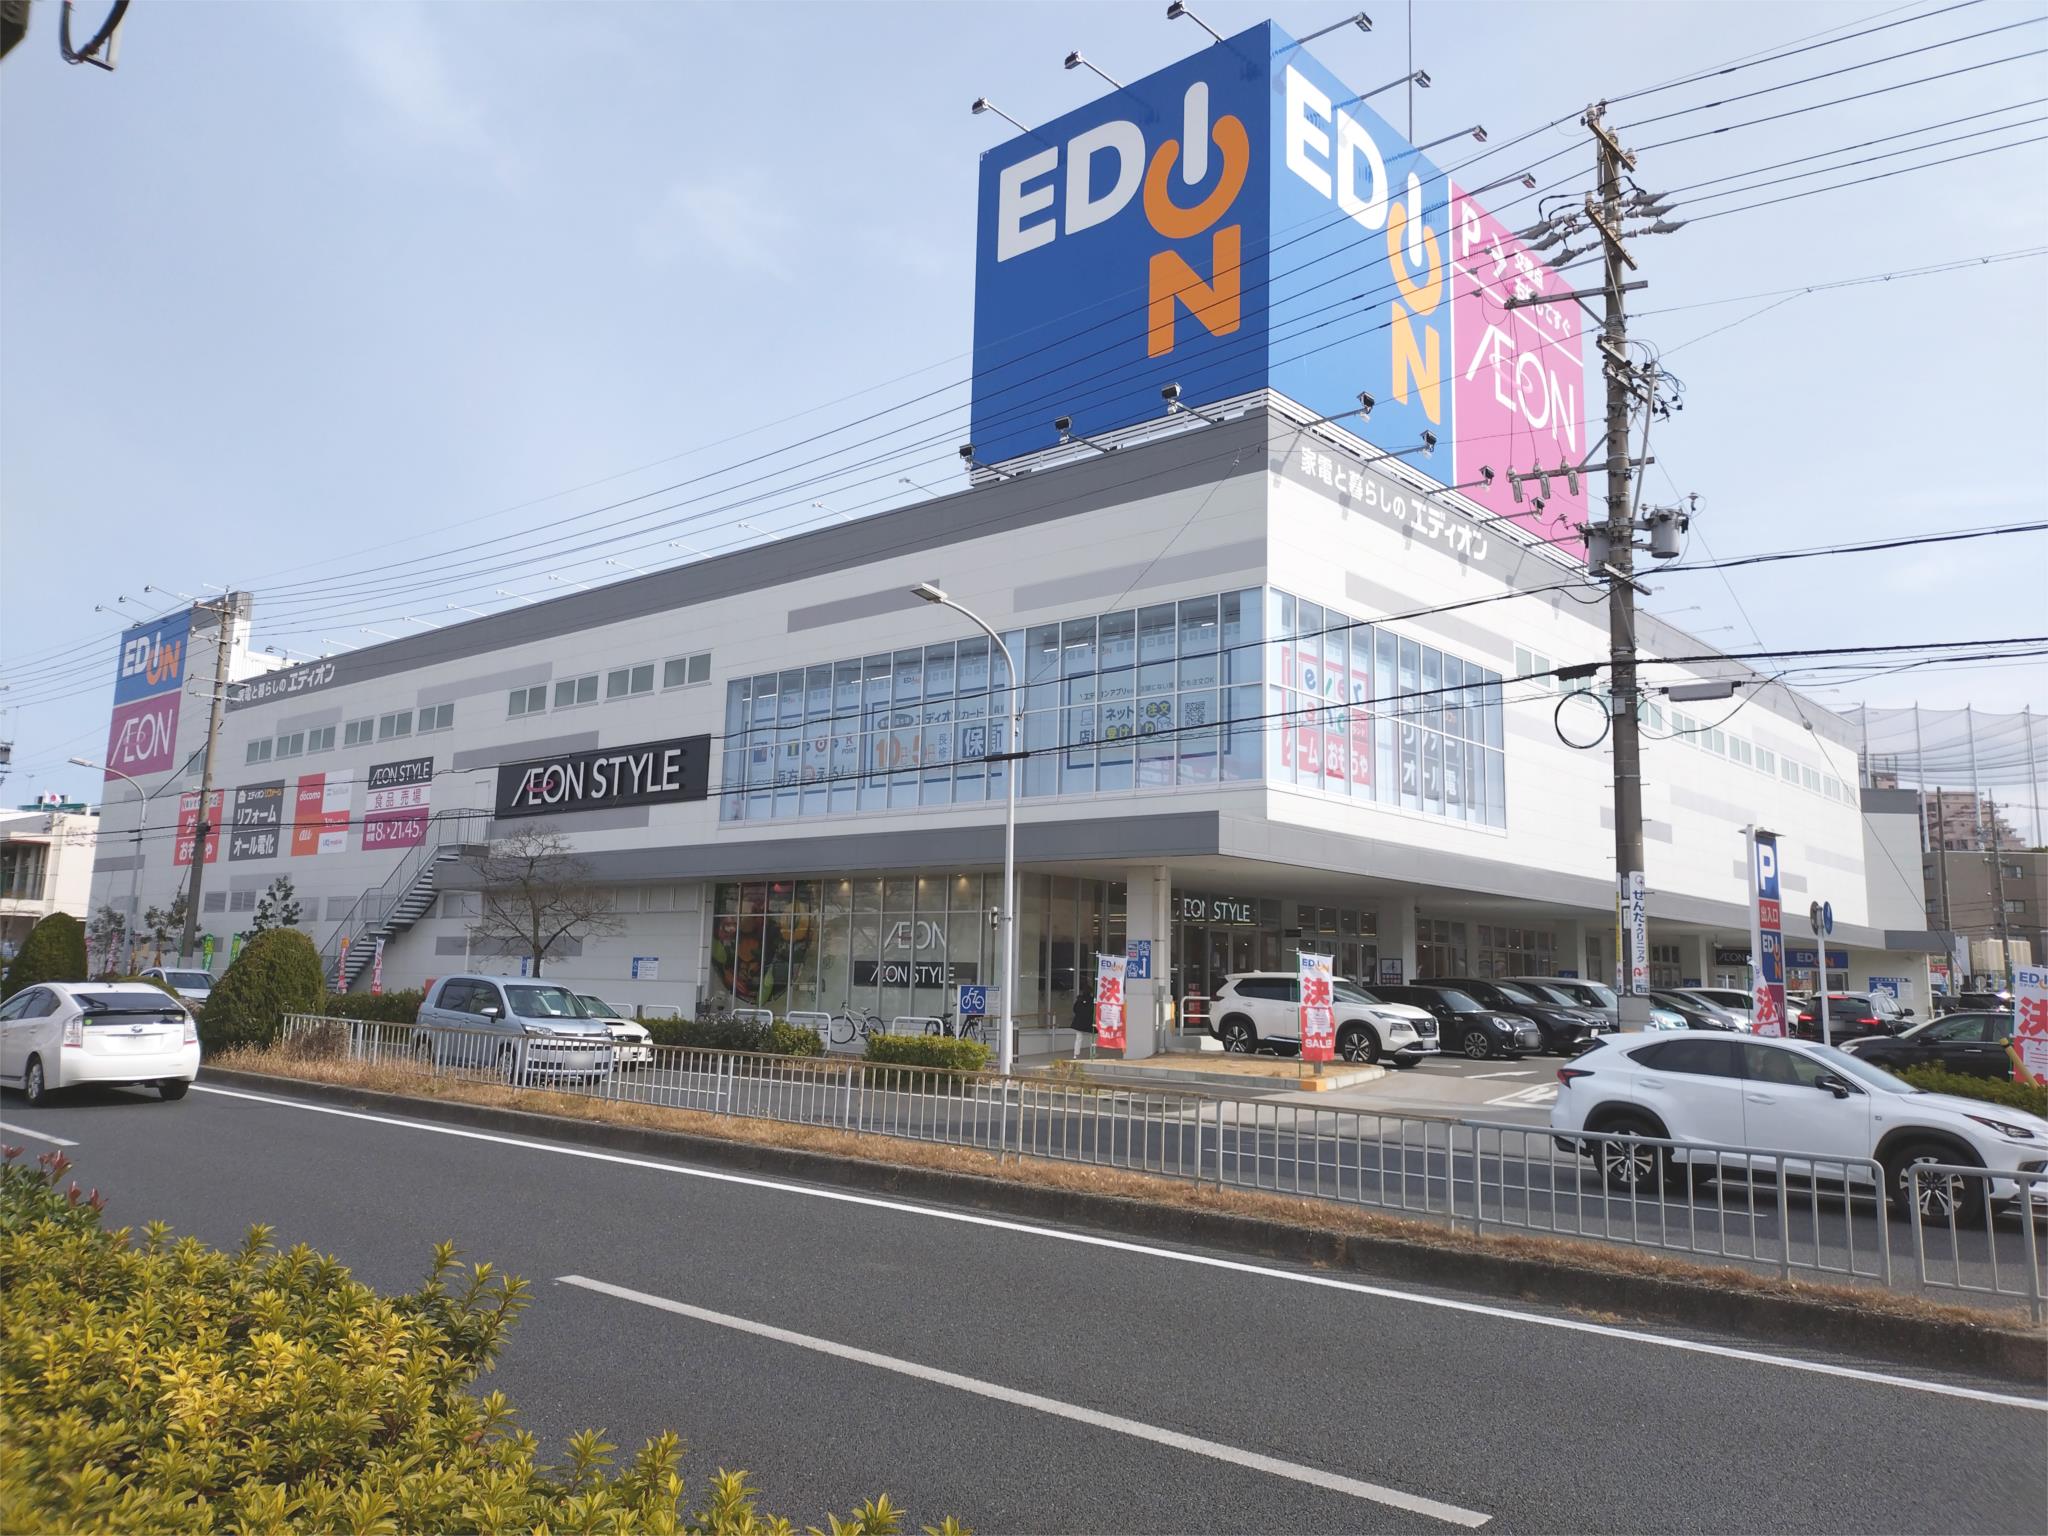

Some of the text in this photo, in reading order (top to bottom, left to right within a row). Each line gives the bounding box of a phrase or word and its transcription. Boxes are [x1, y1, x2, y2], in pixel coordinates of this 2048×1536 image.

[998, 81, 1250, 358] EDION
[1461, 200, 1481, 257] P
[1301, 447, 1487, 560] 家電と暮らしの エディオン
[122, 632, 181, 685] EDION
[288, 664, 335, 691] エディオン
[400, 762, 430, 782] STYLE
[591, 748, 681, 799] STYLE
[299, 790, 321, 801] docomo
[375, 787, 422, 809] 食品売場
[237, 805, 276, 824] リフォーム
[179, 841, 213, 861] おもゃ
[233, 834, 275, 857] オール電化
[1758, 844, 1775, 890] P
[1214, 901, 1250, 922] STYLE
[1760, 907, 1778, 923] 出入口
[1305, 1039, 1332, 1048] SALE
